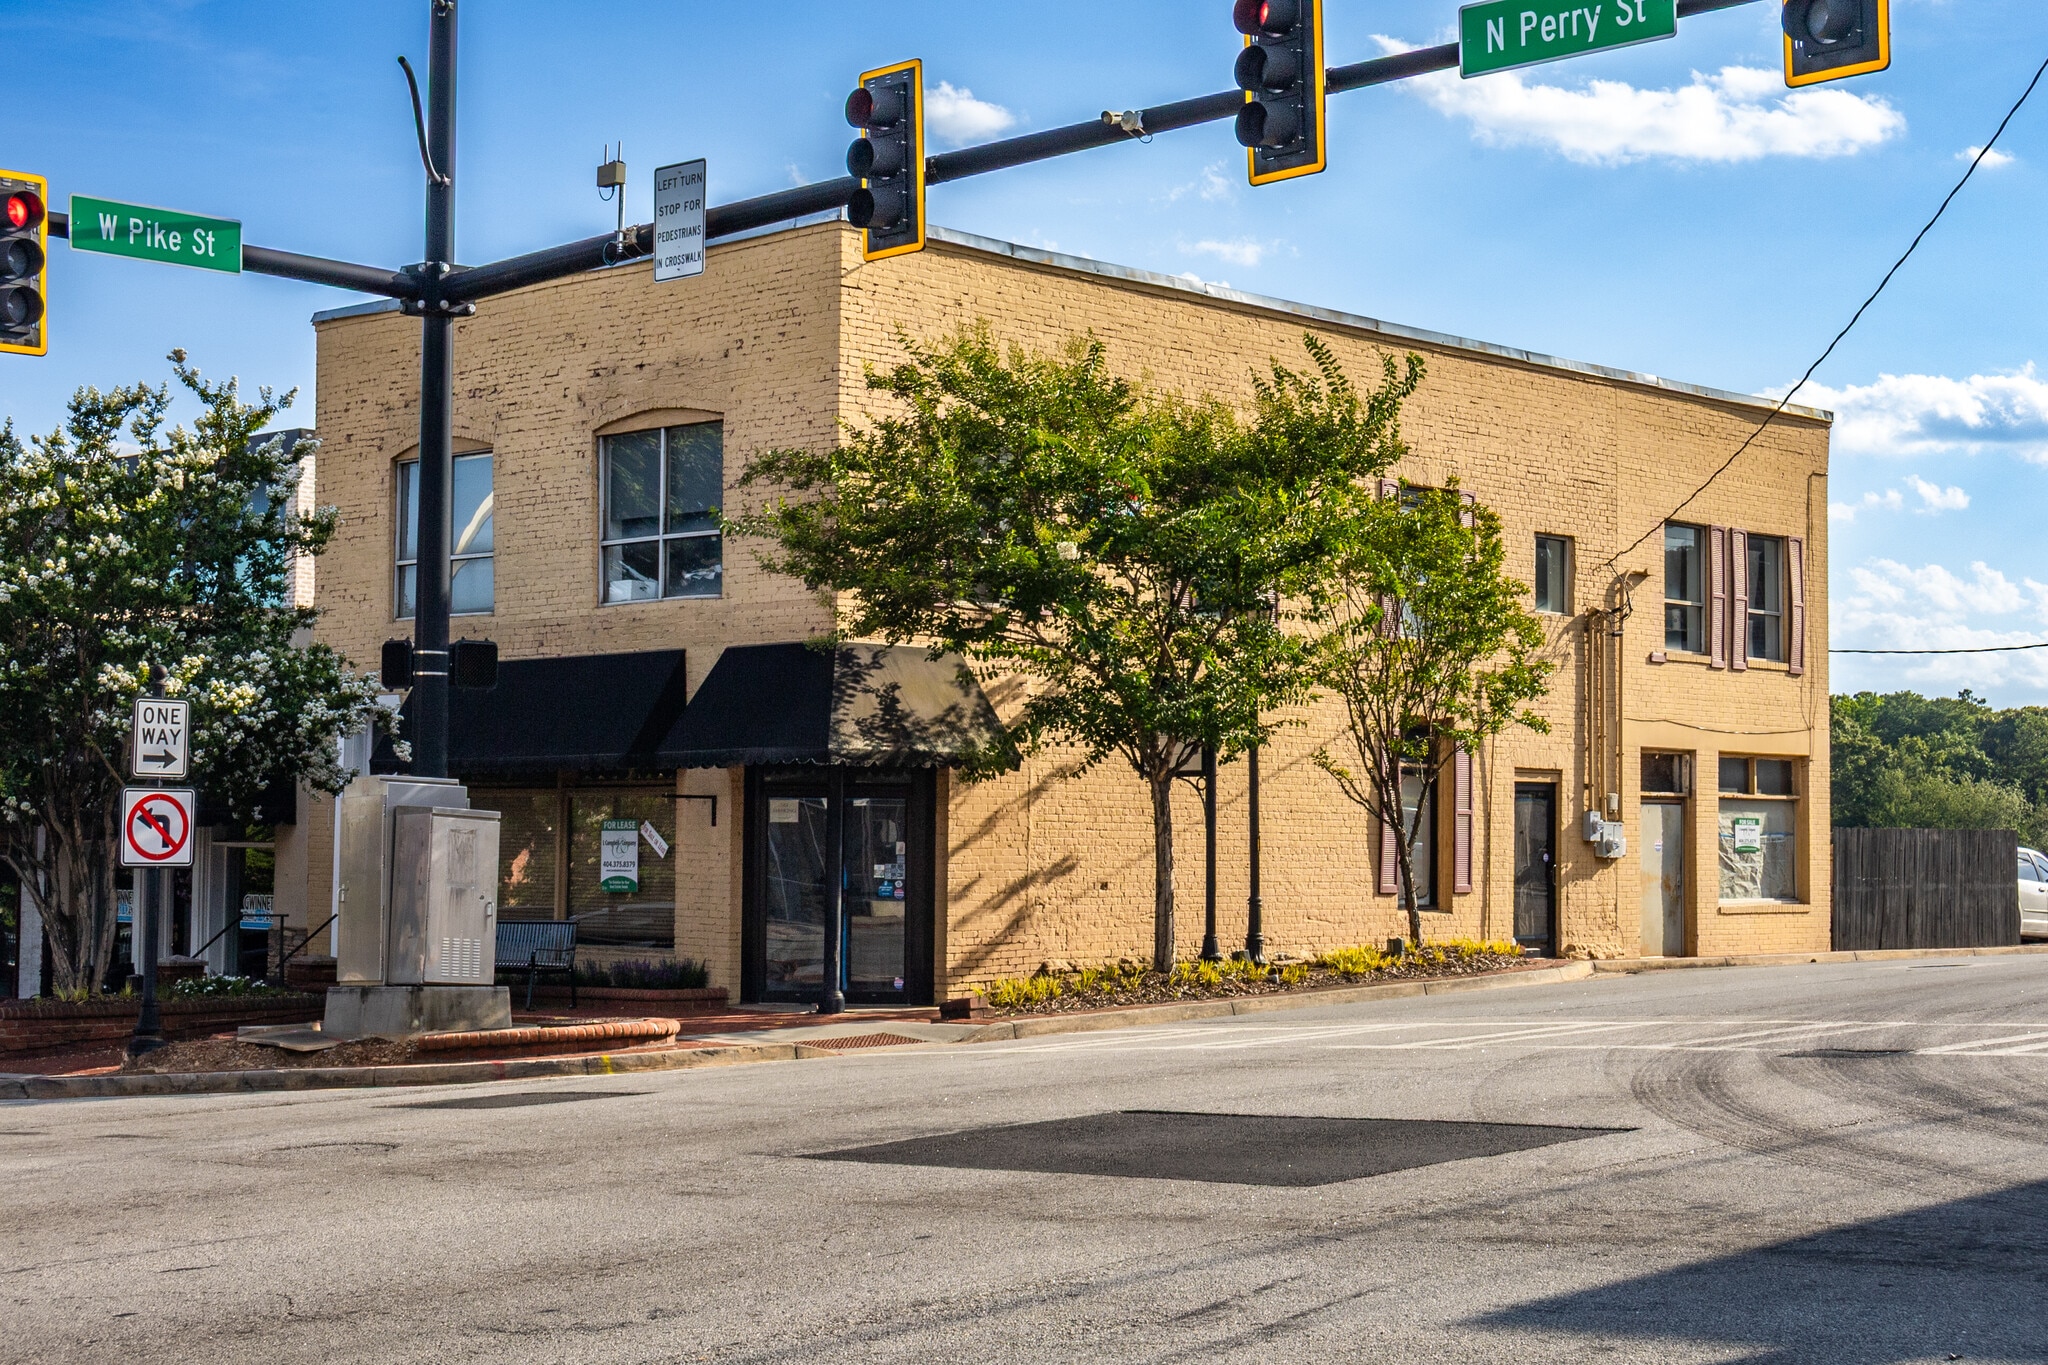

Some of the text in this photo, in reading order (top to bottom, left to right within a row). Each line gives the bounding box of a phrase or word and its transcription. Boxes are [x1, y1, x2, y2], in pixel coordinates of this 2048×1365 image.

[1487, 0, 1647, 53] N Perry St
[657, 172, 703, 192] LEFT TURN
[658, 198, 701, 217] STOP FOR
[99, 212, 215, 257] W Pike St
[657, 225, 702, 243] PEDESTRIANS
[656, 251, 702, 269] IN CROSSWALK
[143, 707, 181, 725] ONE
[142, 728, 181, 745] WAY
[603, 821, 636, 830] FOR LEASE
